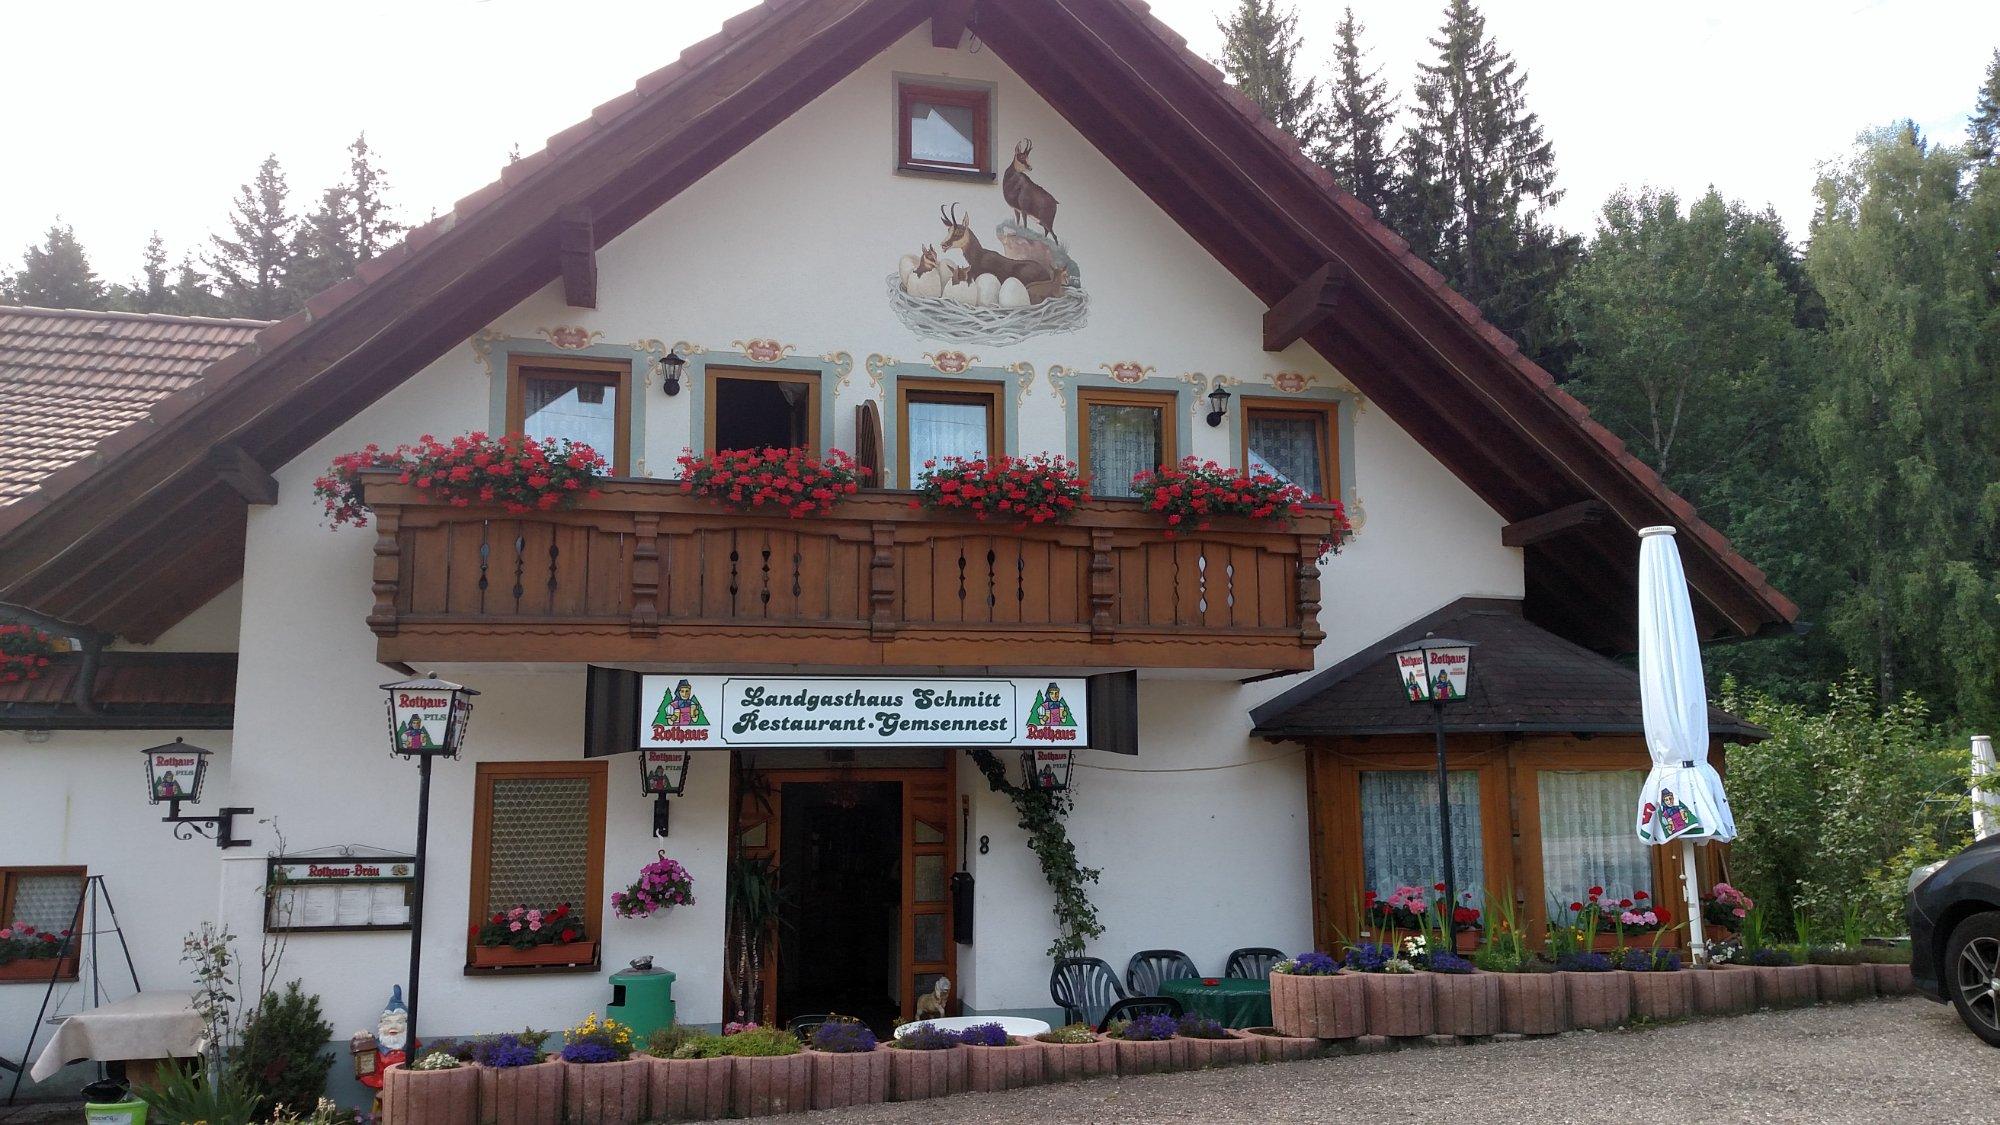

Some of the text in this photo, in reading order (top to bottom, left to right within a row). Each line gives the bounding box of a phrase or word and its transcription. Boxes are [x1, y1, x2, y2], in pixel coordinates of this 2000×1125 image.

[1430, 652, 1466, 665] Rothaus
[398, 693, 448, 710] Rothaus
[741, 686, 1001, 711] Landgasthaus Schmitt
[424, 713, 447, 721] PILS
[732, 709, 1008, 736] Restaurant Gemsennest
[651, 724, 709, 744] Rothaus
[1026, 724, 1077, 743] Rothaus
[156, 755, 195, 768] Rothaus
[649, 751, 683, 763] Rothaus
[1037, 751, 1067, 762] Rothaus
[980, 835, 990, 855] 8
[307, 863, 381, 879] Rothaus-Bräu
